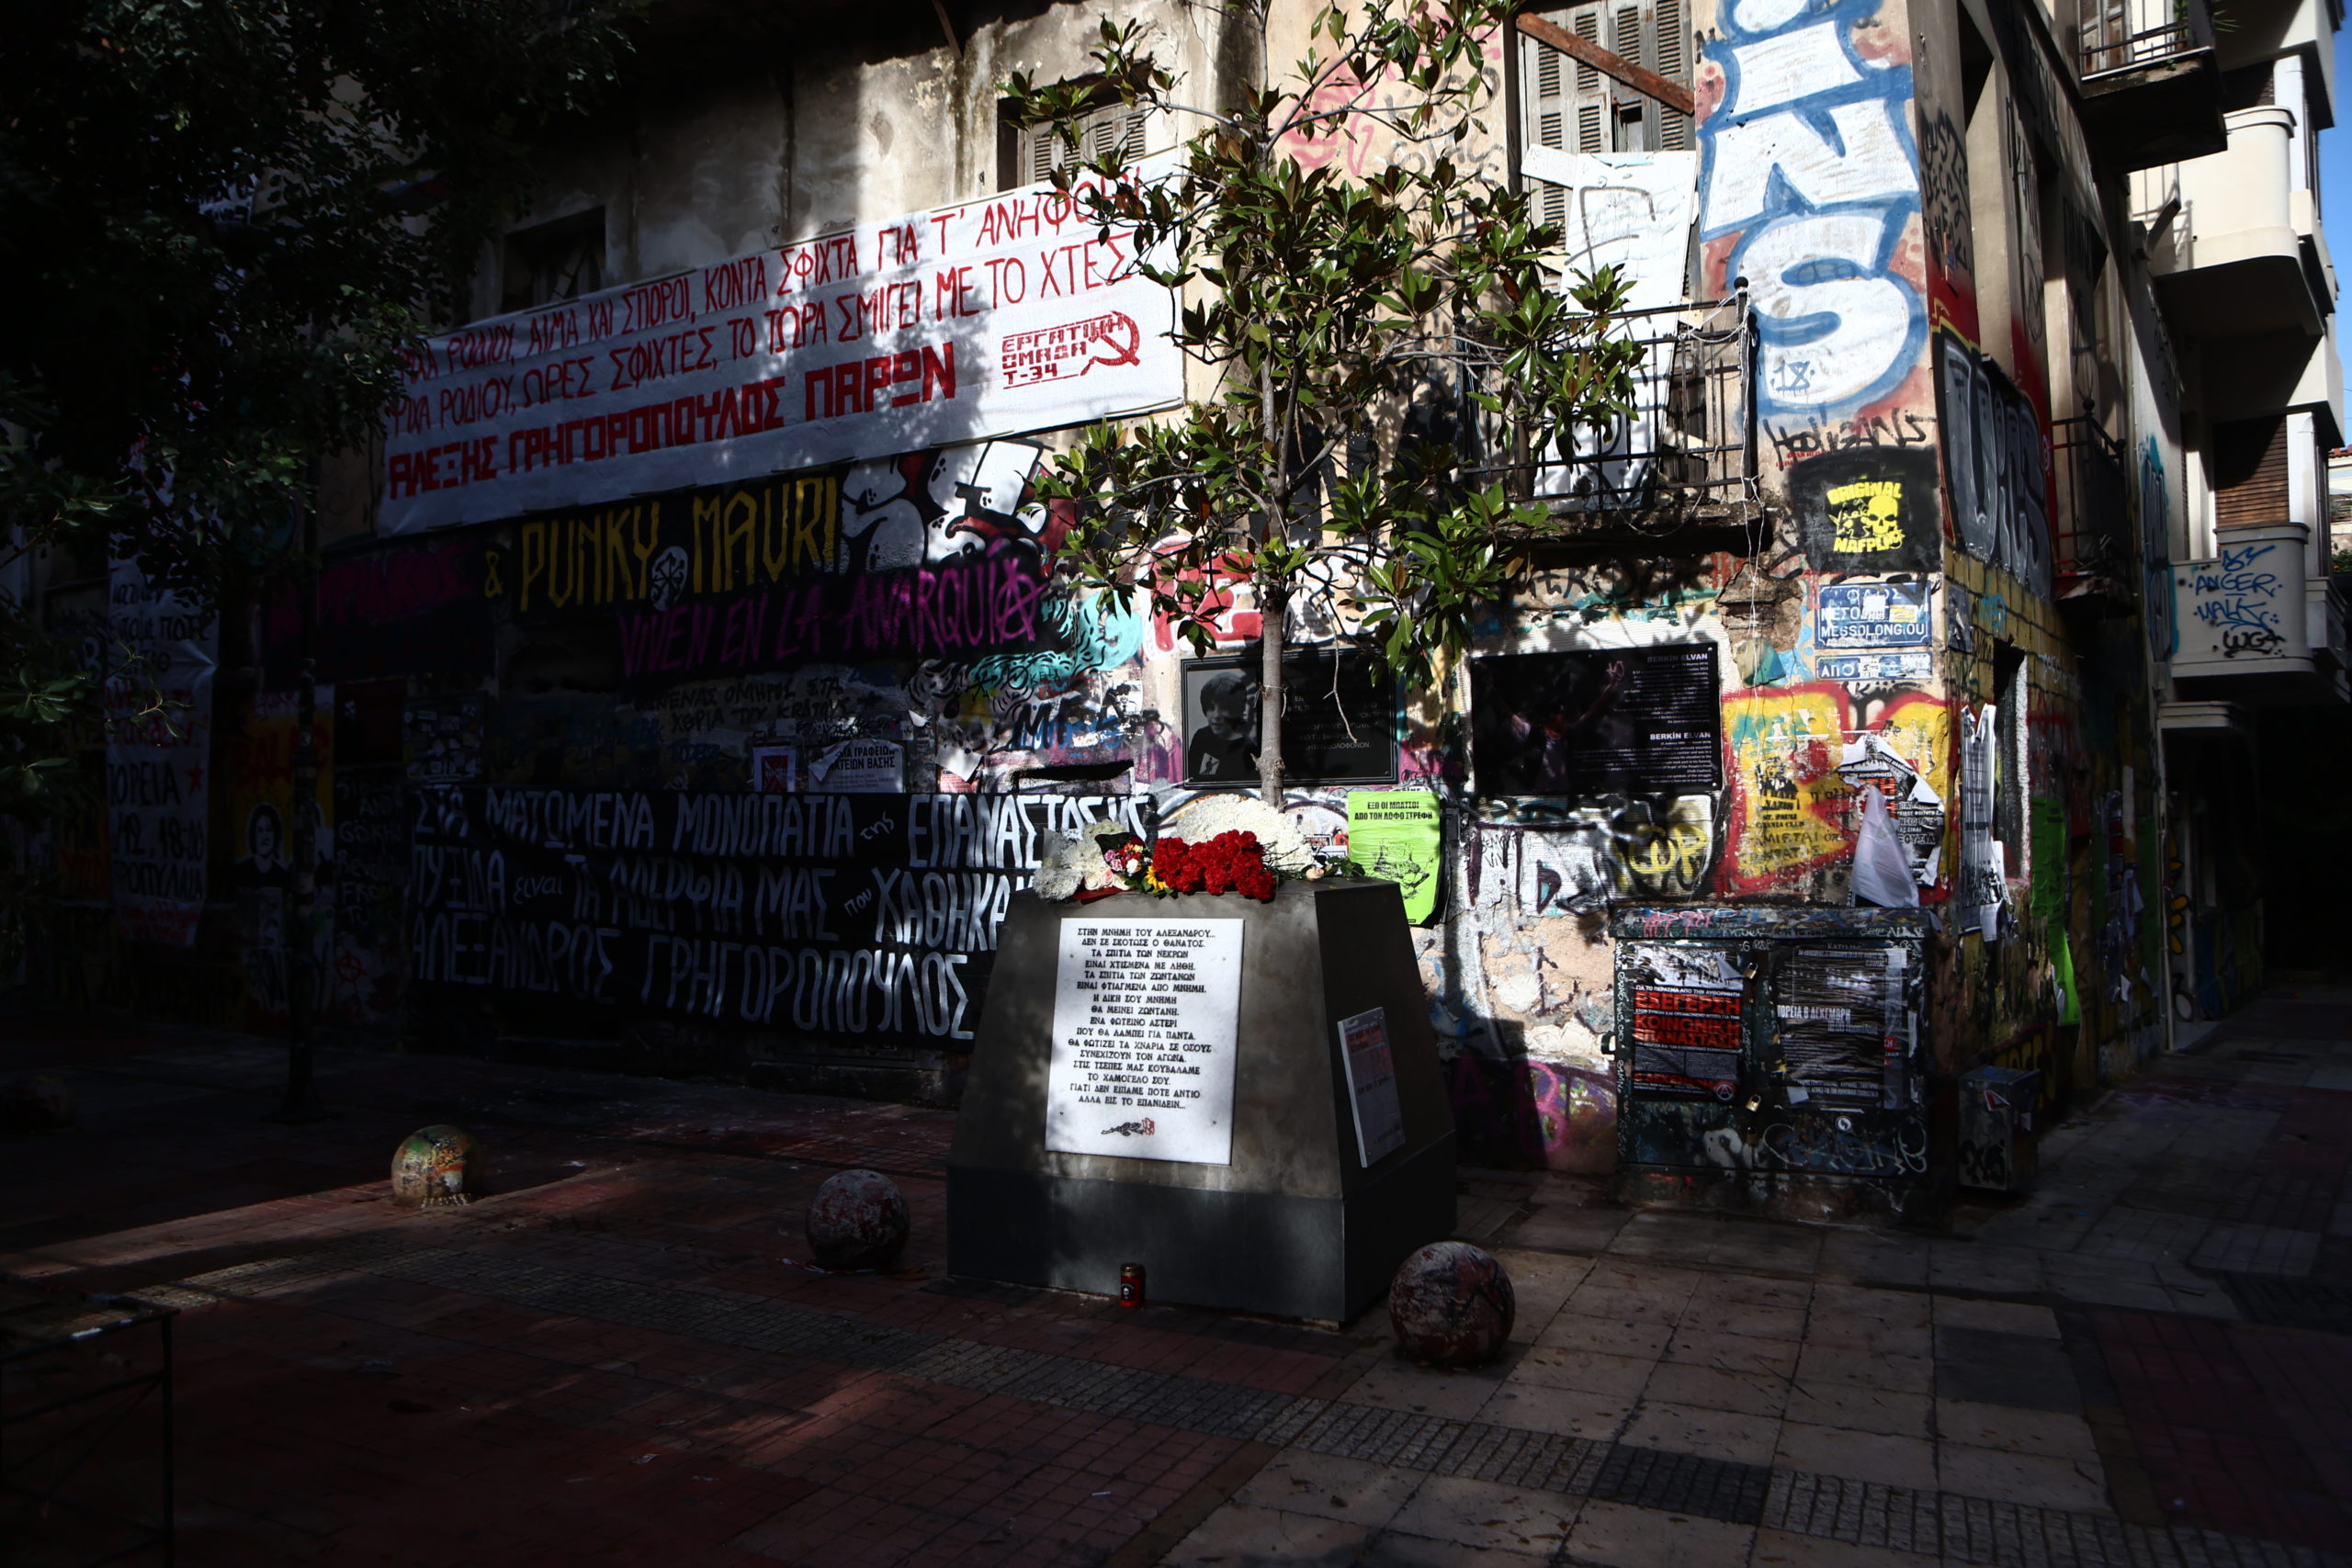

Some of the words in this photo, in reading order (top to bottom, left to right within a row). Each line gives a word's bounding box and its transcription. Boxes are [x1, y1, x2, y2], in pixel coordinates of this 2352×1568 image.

[447, 323, 515, 370] ΡΟΔΙΟΥ,
[530, 309, 578, 352] ΑΙΜΑ
[589, 298, 614, 337] ΚΑΙ
[623, 276, 695, 334] ΣΠΟΡΟΙ,
[706, 256, 766, 313] ΚΟΝΤΑ
[776, 235, 857, 296] ΣΦΙΧΤΑ
[878, 229, 918, 271] ΓΙΑ
[441, 373, 515, 429] ΡΟΔΙΟΥ,
[523, 356, 594, 408] ΩΡΕΣ
[610, 325, 718, 391] ΣΦΙΧΤΕΣ,
[728, 319, 756, 361] ΤΟ
[764, 301, 827, 355] ΤΩΡΑ
[836, 279, 922, 343] ΣΜΙΓΕΙ
[936, 266, 979, 321] ΜΕ
[984, 257, 1025, 310] ΤΟ
[1002, 342, 1088, 369] ΟΜΑΔΑ
[390, 436, 497, 500] ΑΛΕΞΗΣ
[509, 378, 786, 473] ΓΡΗΓΟΡΟΠΟΥΛΟΣ
[805, 341, 955, 422] ΠΑΡΩΝ
[1826, 481, 1902, 504] ORIGINAL
[520, 501, 660, 612] PUNKY
[693, 476, 837, 593] MAURI
[618, 604, 715, 678] VIVEN
[720, 592, 769, 666] EN
[774, 583, 831, 660] LA
[1822, 624, 1925, 637] MESSOLONGIOU
[1680, 653, 1708, 661] ELVAN
[1821, 664, 1854, 677] ΑΠΟ
[867, 755, 895, 769] ΒΑΣΗΣ
[416, 784, 469, 838] ΣΤΑ
[673, 792, 854, 858] ΜΟΝΟΠΑΤΙΑ
[1354, 812, 1368, 820] ΑΠΟ
[413, 844, 505, 917] ΠΥΞΙΔΑ
[564, 853, 600, 922] ΤΑ
[754, 867, 840, 942] ΜΑΣ
[1078, 928, 1098, 936] ΣΤΗΝ
[1102, 928, 1131, 936] ΜΝΗΜΗ
[1091, 949, 1102, 957] ΤΑ
[1110, 961, 1149, 969] ΧΤΙΣΜΕΝΑ
[1155, 962, 1166, 970] ΜΕ
[1170, 963, 1195, 971] ΛΗΘΗ.
[413, 911, 622, 1005] ΑΛΕΞΑΝΔΡΟΣ
[641, 933, 975, 1040] ΓΡΗΓΟΡΟΠΟΥΛΟΣ
[1099, 971, 1125, 979] ΣΠΙΤΙΑ
[1130, 972, 1146, 980] ΤΩΝ
[1150, 973, 1195, 981] ΖΩΝΤΑΝΩΝ
[1102, 982, 1147, 991] ΦΤΙΑΓΜΕΝΑ
[1173, 985, 1206, 993] ΜΝΗΜΗ.
[1125, 995, 1142, 1003] ΣΟΥ
[1146, 996, 1177, 1004] ΜΝΗΜΗ
[1635, 991, 1741, 1015] ΕΞΕΓΕΡΣΗ
[1107, 1006, 1134, 1014] ΜΕΙΝΕΙ
[1138, 1007, 1180, 1016] ΖΩΝΤΑΝΗ.
[1811, 1007, 1850, 1021] ΔΕΚΕΜΒΡΗ
[1091, 1017, 1105, 1025] ΕΝΑ
[1110, 1018, 1146, 1026] ΦΩΤΕΙΝΟ
[1149, 1019, 1177, 1028] ΑΣΤΕΡΙ
[1635, 1014, 1741, 1035] ΚΟΙΝΩΝΙΚΗ
[1098, 1028, 1109, 1036] ΘΑ
[1114, 1029, 1144, 1037] ΛΑΜΠΕΙ
[1148, 1030, 1161, 1038] ΓΙΑ
[1166, 1032, 1196, 1040] ΠΑΝΤΑ.
[1634, 1028, 1740, 1048] ΕΠΑΝΑΣΤΑΣΗ
[1084, 1039, 1115, 1048] ΦΩΤΙΖΕΙ
[1119, 1041, 1129, 1049] ΤΑ
[1135, 1042, 1165, 1050] ΧΝΑΡΙΑ
[1169, 1043, 1179, 1051] ΣΕ
[1182, 1043, 1212, 1053] ΟΣΟΥΣ
[1080, 1050, 1131, 1059] ΣΥΝΕΧΙΖΟΥΝ
[1136, 1052, 1153, 1060] ΤΟΝ
[1157, 1054, 1187, 1063] ΑΓΩΝΑ.
[1095, 1062, 1123, 1070] ΤΣΕΠΕΣ
[1126, 1063, 1144, 1072] ΜΑΣ
[1148, 1064, 1201, 1075] ΚΟΥΒΑΛΑΜΕ
[1088, 1073, 1099, 1081] ΤΟ
[1102, 1074, 1148, 1084] ΧΑΜΟΓΕΛΟ
[1152, 1077, 1170, 1085] ΣΟΥ.
[1070, 1083, 1091, 1091] ΓΙΑΤΙ
[1095, 1084, 1109, 1092] ΔΕΝ
[1114, 1086, 1143, 1095] ΕΙΠΑΜΕ
[1148, 1088, 1170, 1097] ΠΟΤΕ
[1173, 1089, 1200, 1099] ΑΝΤΙΟ
[1122, 1097, 1133, 1106] ΤΟ
